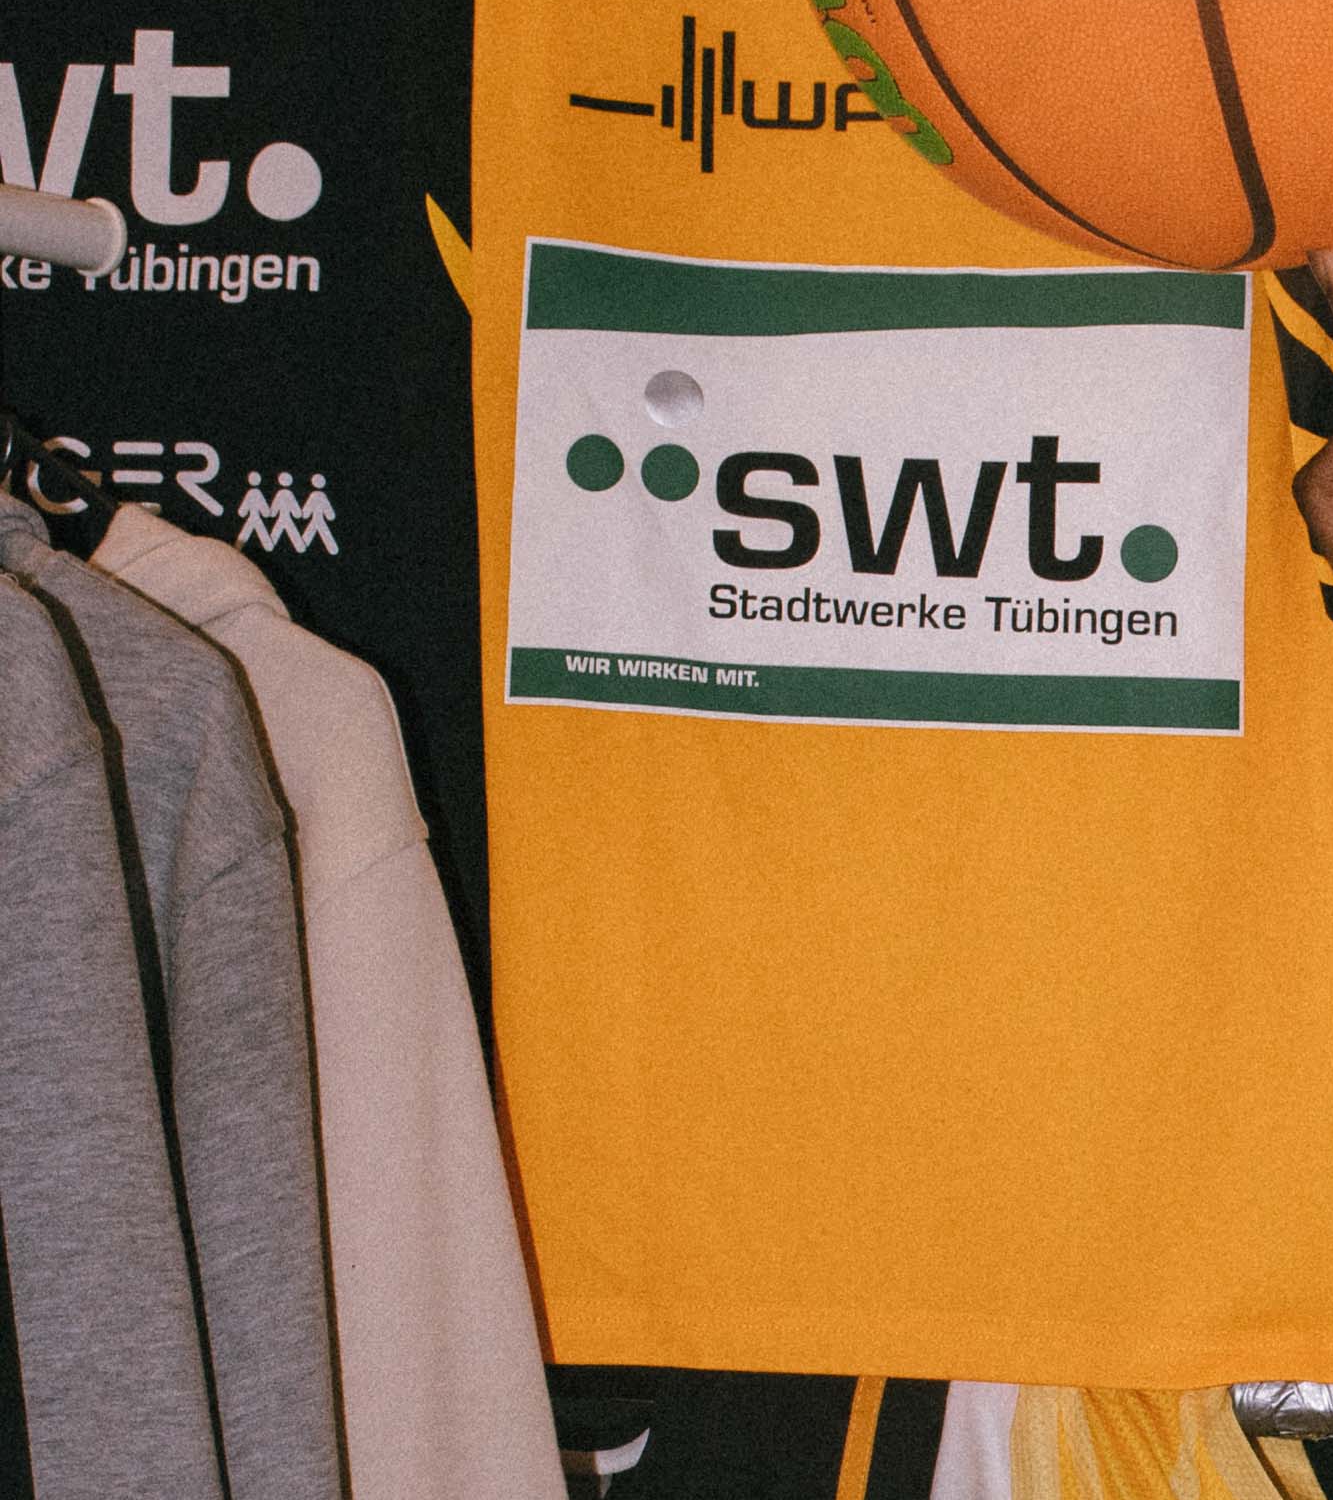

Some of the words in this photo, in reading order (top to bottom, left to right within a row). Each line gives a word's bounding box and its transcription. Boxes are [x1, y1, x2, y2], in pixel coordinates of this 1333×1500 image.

[708, 583, 968, 631] Stadtwerke
[984, 594, 1179, 645] Tübingen
[564, 653, 612, 676] WIR
[617, 657, 710, 685] WIRKEN
[715, 665, 760, 688] MIT.
